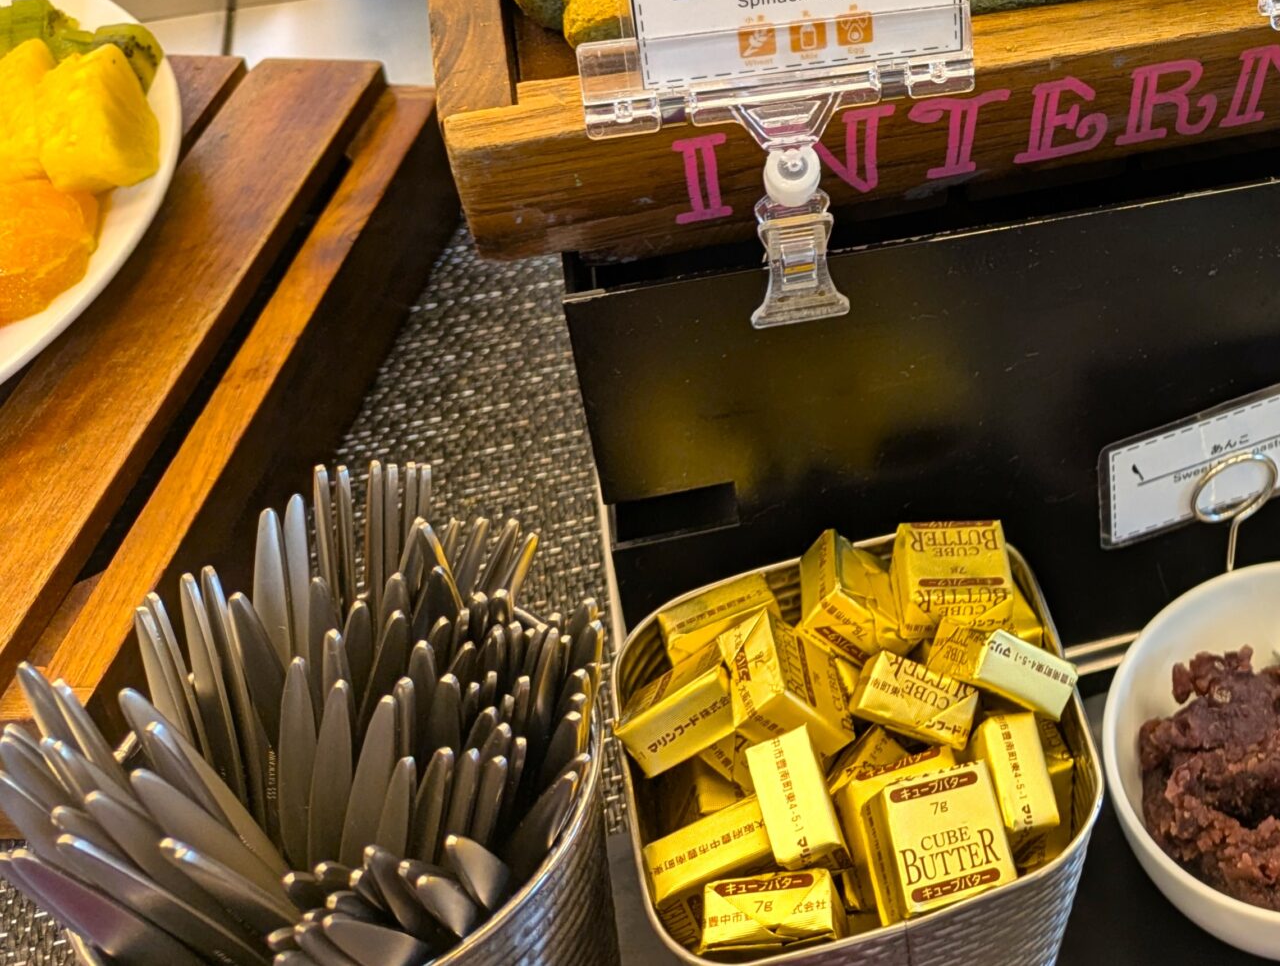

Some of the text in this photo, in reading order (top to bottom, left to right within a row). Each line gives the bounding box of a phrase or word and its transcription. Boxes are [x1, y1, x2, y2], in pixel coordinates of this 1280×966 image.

[1211, 434, 1250, 455] あんこ
[909, 528, 999, 553] BUTTER
[933, 547, 980, 557] CUBE
[904, 679, 950, 710] CUBE
[900, 776, 969, 800] キューブバター
[930, 801, 949, 815] 7g
[920, 825, 971, 851] CUBE
[899, 828, 1002, 886] BUTTER
[724, 878, 803, 895] キューブバター
[921, 874, 991, 900] キューブバター
[754, 900, 774, 913] 7g
